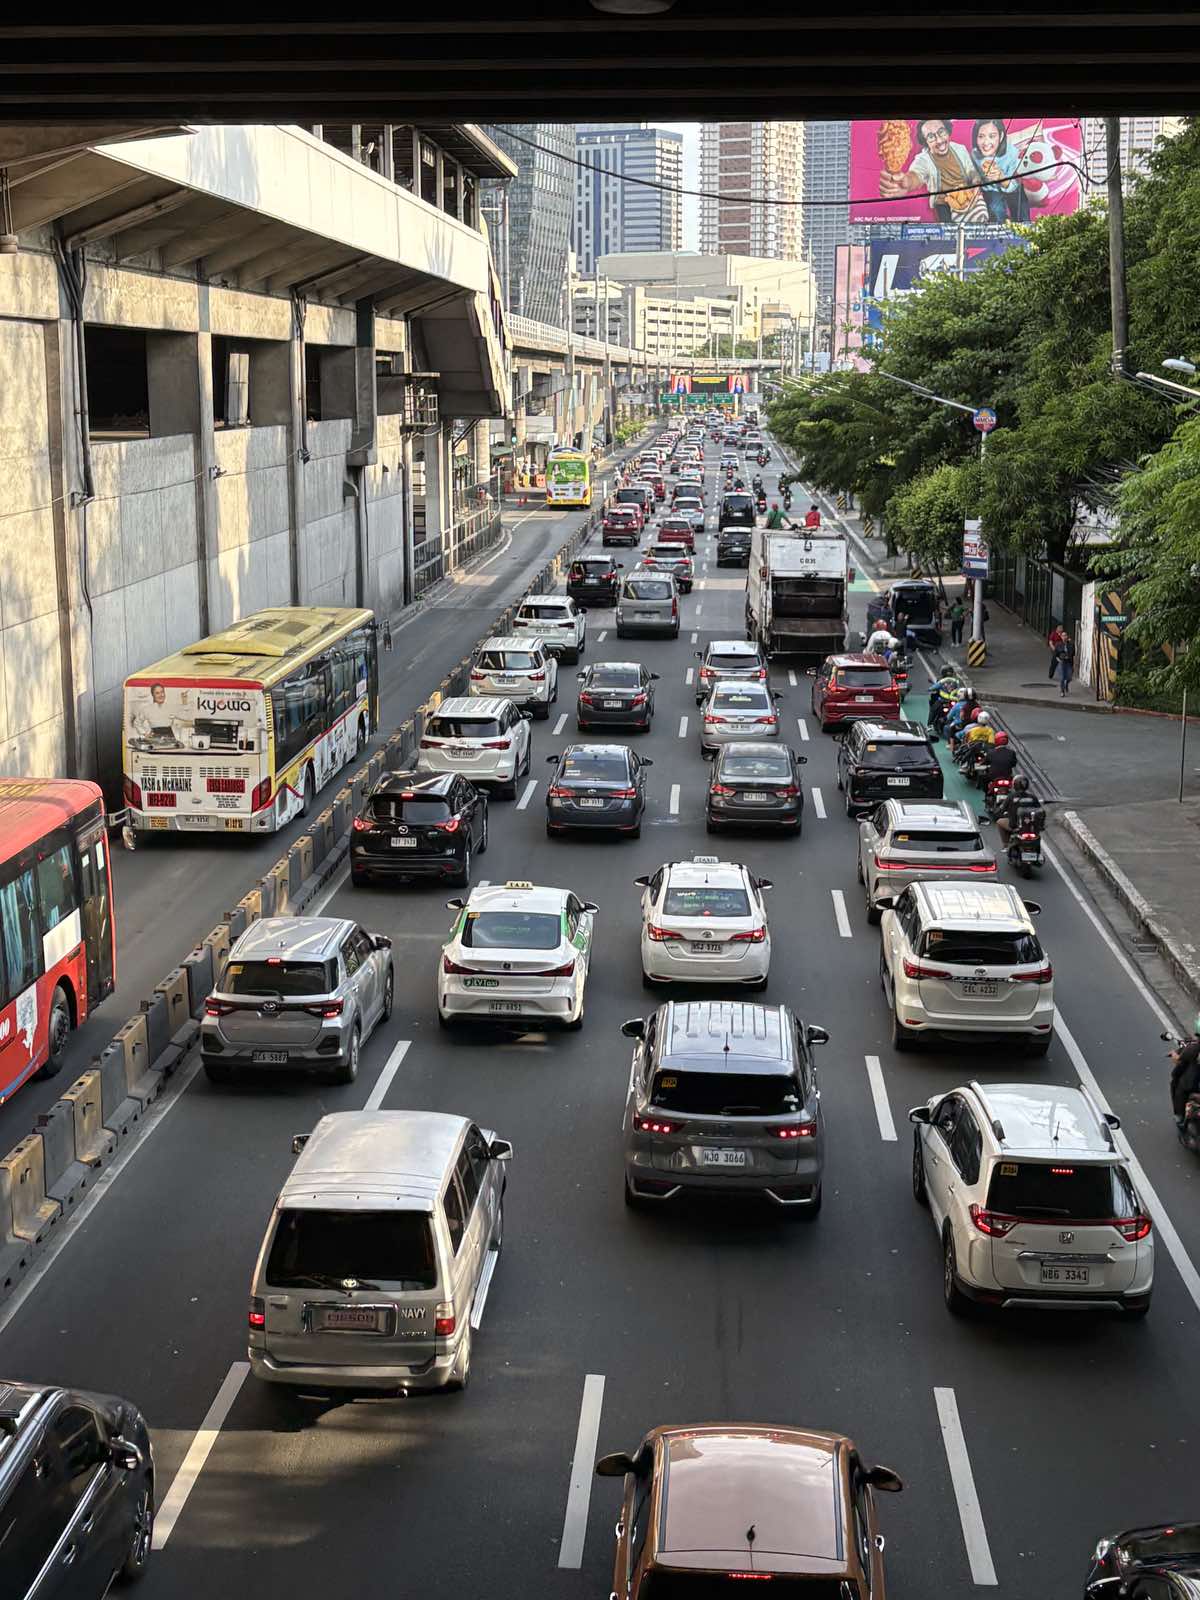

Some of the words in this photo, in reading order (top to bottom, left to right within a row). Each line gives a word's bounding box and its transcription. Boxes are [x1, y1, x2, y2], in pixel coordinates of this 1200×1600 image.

[197, 696, 251, 715] kyowa
[724, 1152, 744, 1163] 3066
[1065, 1271, 1087, 1280] 3341
[401, 1307, 426, 1319] NAVY
